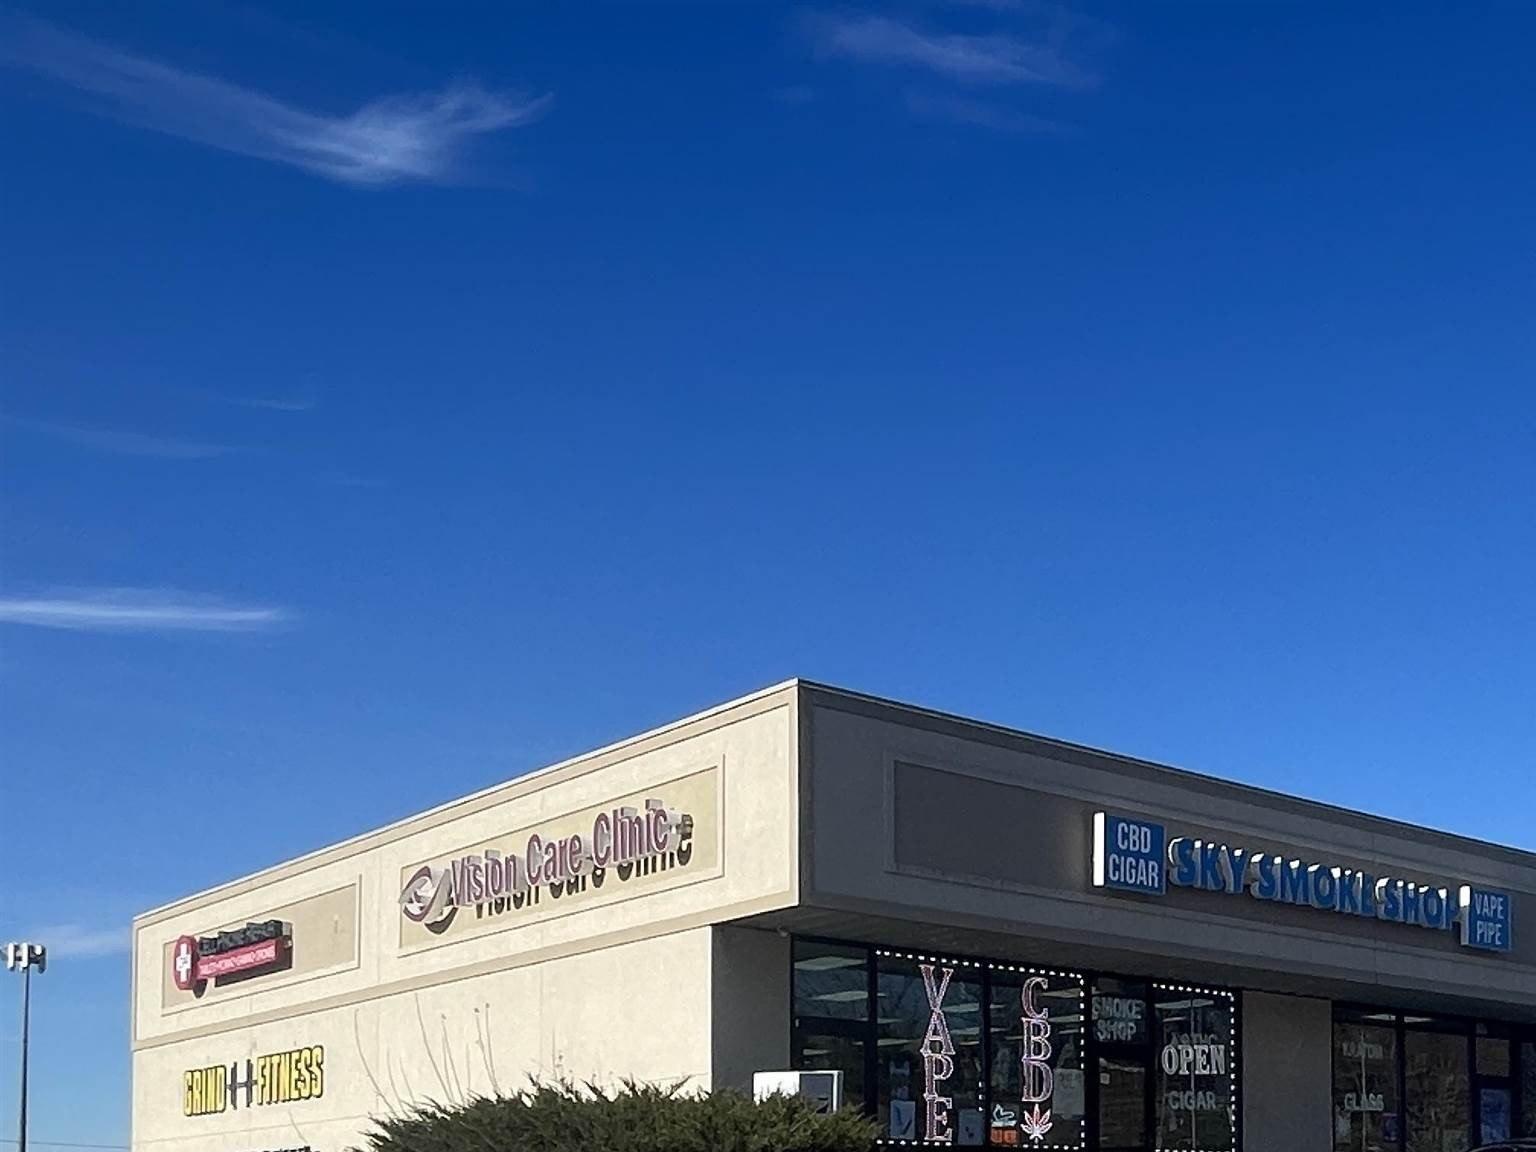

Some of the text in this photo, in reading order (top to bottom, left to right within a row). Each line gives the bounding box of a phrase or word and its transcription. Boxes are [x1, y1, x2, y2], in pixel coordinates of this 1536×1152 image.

[451, 798, 669, 907] Vision Care Clinic
[1117, 821, 1152, 854] CBD
[1109, 853, 1159, 889] CIGAR
[1168, 836, 1460, 931] SKY SMOKE SHOP
[1474, 893, 1505, 920] VAPE
[1476, 920, 1503, 945] PIPE
[1091, 996, 1142, 1019] SMOKE
[1020, 976, 1054, 1103] CBD
[1096, 1019, 1137, 1041] SHOP
[918, 964, 956, 1141] VAPE
[1161, 1043, 1226, 1076] OPEN
[184, 1045, 324, 1117] GRIND FITNESS
[1167, 1090, 1217, 1111] CIGAR
